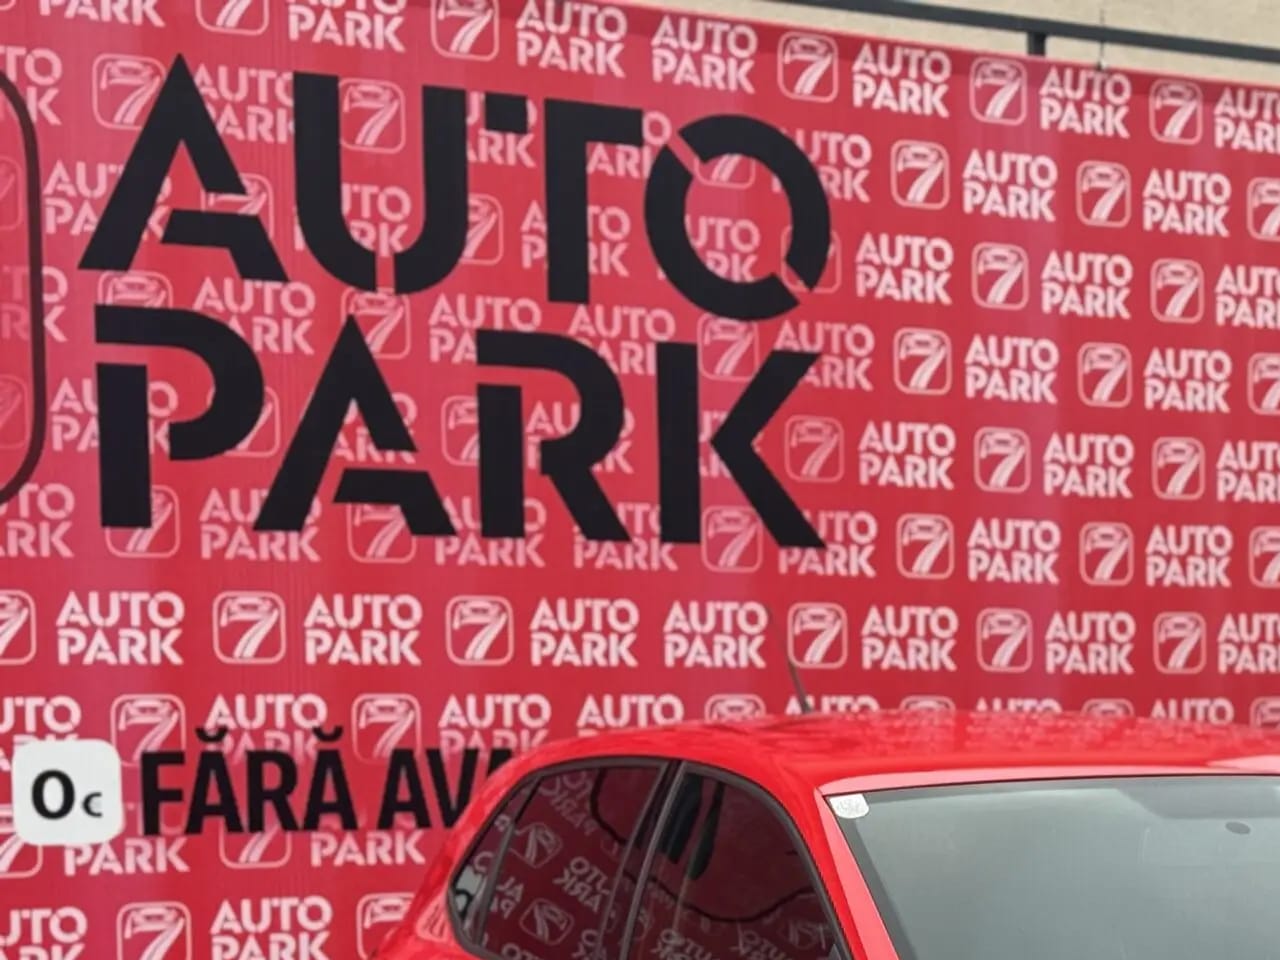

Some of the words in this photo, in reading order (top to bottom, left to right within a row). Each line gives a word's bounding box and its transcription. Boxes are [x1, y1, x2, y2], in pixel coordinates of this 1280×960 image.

[289, 6, 405, 53] PARK
[516, 1, 627, 41] AUTO
[652, 15, 758, 58] AUTO
[517, 30, 624, 77] PARK
[653, 48, 753, 93] PARK
[853, 43, 951, 83] AUTO
[853, 73, 948, 117] PARK
[1040, 67, 1131, 104] AUTO
[1040, 97, 1129, 138] PARK
[78, 53, 830, 320] AUTO
[963, 149, 1057, 188] AUTO
[964, 180, 1055, 221] PARK
[1143, 170, 1231, 205] AUTO
[1144, 198, 1228, 237] PARK
[857, 234, 953, 271] AUTO
[1041, 251, 1132, 287] AUTO
[193, 277, 316, 317] AUTO
[857, 265, 951, 304] PARK
[1042, 281, 1130, 319] PARK
[428, 294, 541, 332] AUTO
[568, 304, 676, 343] AUTO
[774, 320, 875, 357] AUTO
[965, 336, 1059, 371] AUTO
[1144, 349, 1231, 382] AUTO
[966, 366, 1056, 403] PARK
[1145, 377, 1229, 412] PARK
[94, 304, 827, 548] PARK
[860, 422, 955, 457] AUTO
[1043, 433, 1133, 466] AUTO
[860, 453, 953, 489] PARK
[1044, 463, 1131, 498] PARK
[201, 525, 321, 562] PARK
[435, 533, 545, 568] PARK
[968, 519, 1060, 553] AUTO
[1146, 525, 1232, 556] AUTO
[573, 538, 678, 571] PARK
[778, 545, 876, 578] PARK
[969, 548, 1058, 584] PARK
[1146, 555, 1230, 587] PARK
[57, 592, 184, 628] AUTO
[304, 595, 422, 629] AUTO
[530, 599, 639, 632] AUTO
[664, 602, 767, 634] AUTO
[862, 606, 958, 638] AUTO
[1045, 612, 1135, 642] AUTO
[58, 628, 182, 664] PARK
[306, 628, 420, 665] PARK
[531, 631, 637, 666] PARK
[665, 633, 765, 667] PARK
[863, 637, 956, 670] PARK
[1046, 642, 1133, 673] PARK
[206, 693, 328, 731] AUTO
[438, 694, 552, 729] AUTO
[577, 694, 684, 729] AUTO
[142, 726, 357, 836] FĂRĂ
[64, 837, 190, 877] PARK
[310, 832, 426, 867] PARK
[211, 896, 332, 935] AUTO
